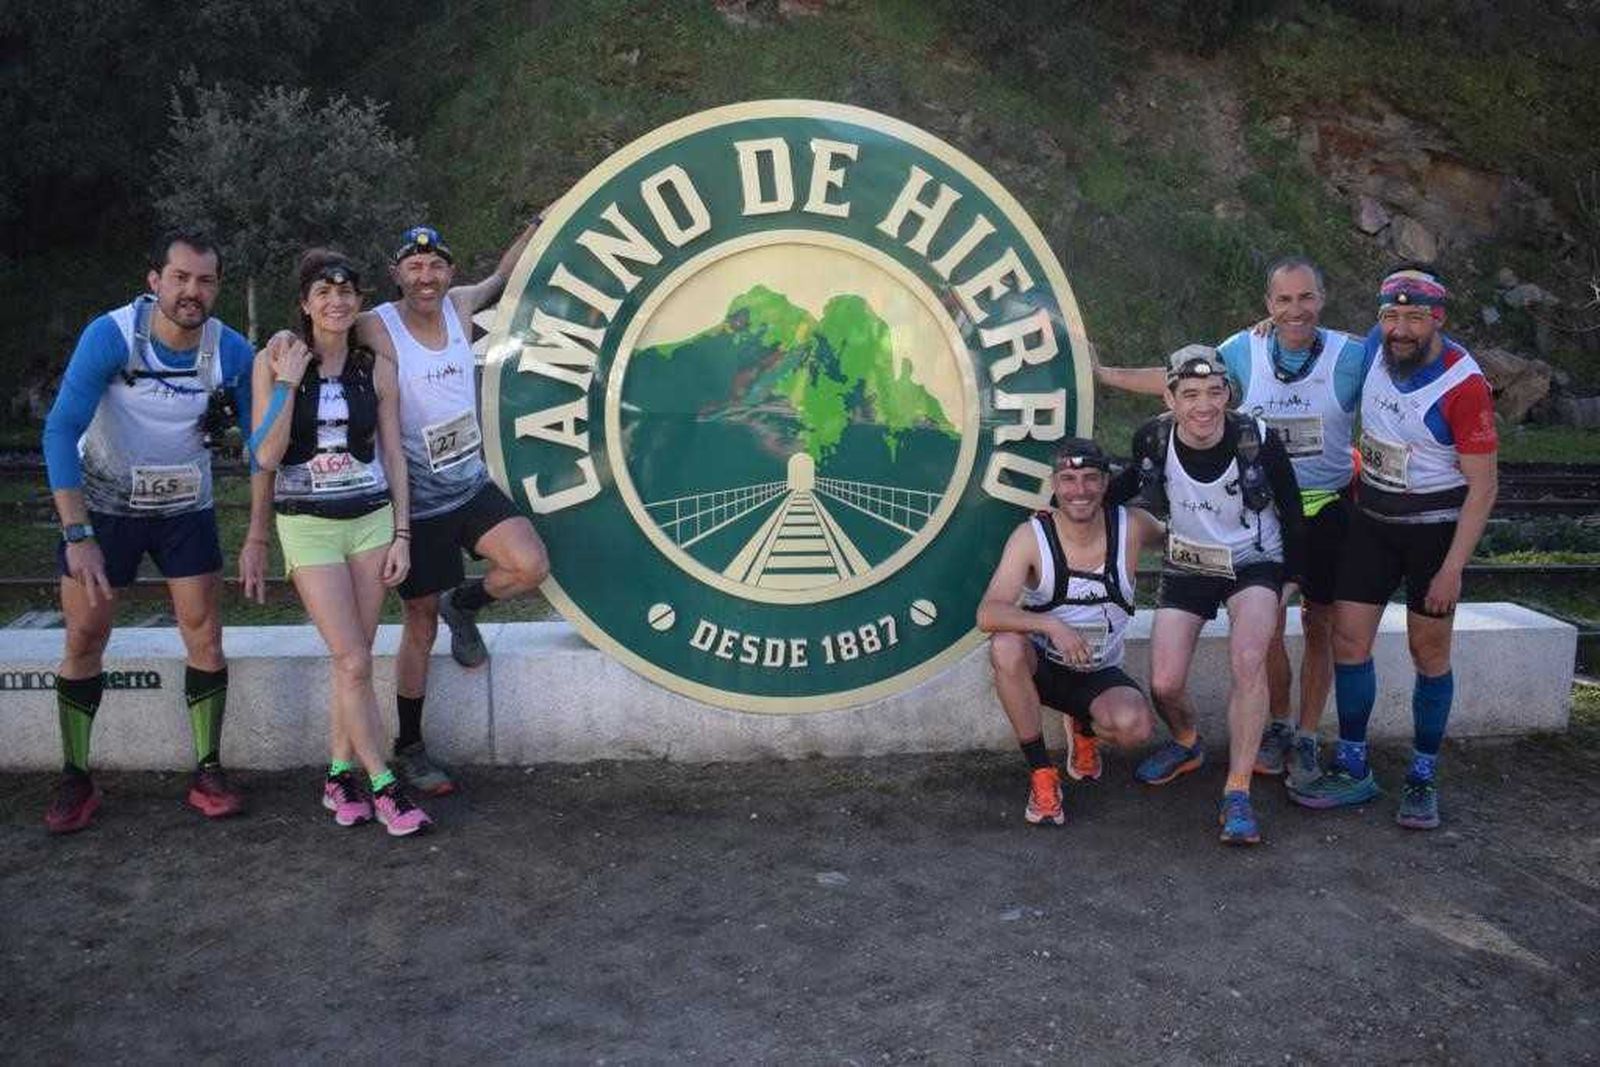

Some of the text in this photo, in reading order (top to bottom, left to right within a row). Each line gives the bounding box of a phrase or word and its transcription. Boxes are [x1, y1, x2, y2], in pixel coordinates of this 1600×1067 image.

[514, 136, 1067, 514] CAMINO DE HIERRO
[137, 478, 179, 496] 165
[689, 614, 899, 668] DESDE 1887
